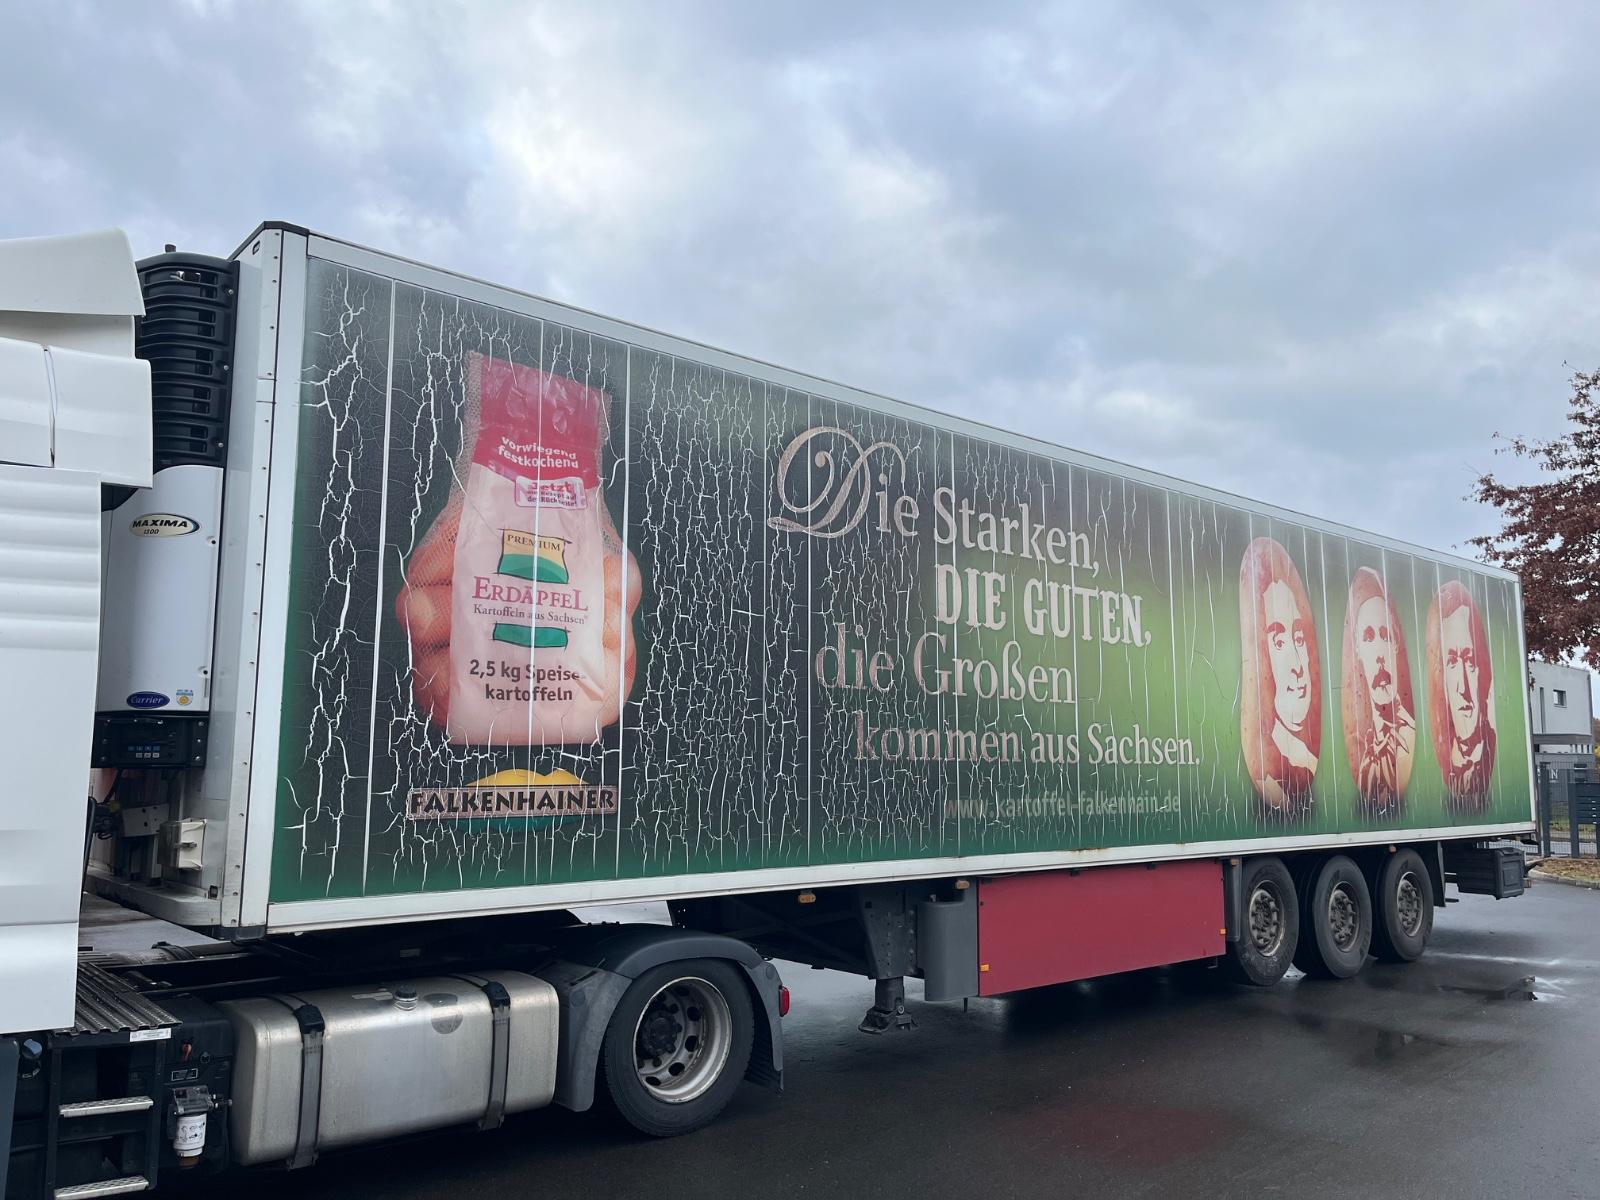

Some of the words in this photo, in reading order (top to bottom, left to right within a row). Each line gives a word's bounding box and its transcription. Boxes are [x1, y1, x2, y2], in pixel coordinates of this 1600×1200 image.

[498, 445, 579, 469] festkochend
[502, 436, 577, 460] vorwiegend
[767, 426, 920, 539] Die
[933, 486, 1100, 578] Starken,
[132, 519, 188, 528] MAXIMA
[507, 534, 561, 551] PREMIUM
[472, 575, 589, 612] ERDÄPFEL
[933, 563, 1007, 631] DIE
[1023, 577, 1152, 648] GUTEN,
[473, 603, 525, 618] Kartoffeln
[527, 610, 545, 621] aus
[469, 659, 496, 679] 2,5
[501, 661, 521, 682] kg
[814, 623, 895, 692] die
[913, 631, 1076, 704] Großen
[130, 696, 164, 704] Carrier
[485, 683, 573, 702] kartoffeln
[852, 709, 1022, 762] kommen
[1030, 731, 1081, 765] aus
[1087, 722, 1201, 766] Sachsen.
[411, 789, 614, 814] FALKENHAINER
[944, 789, 1180, 819] www.kartoffel-falkenhain.de
